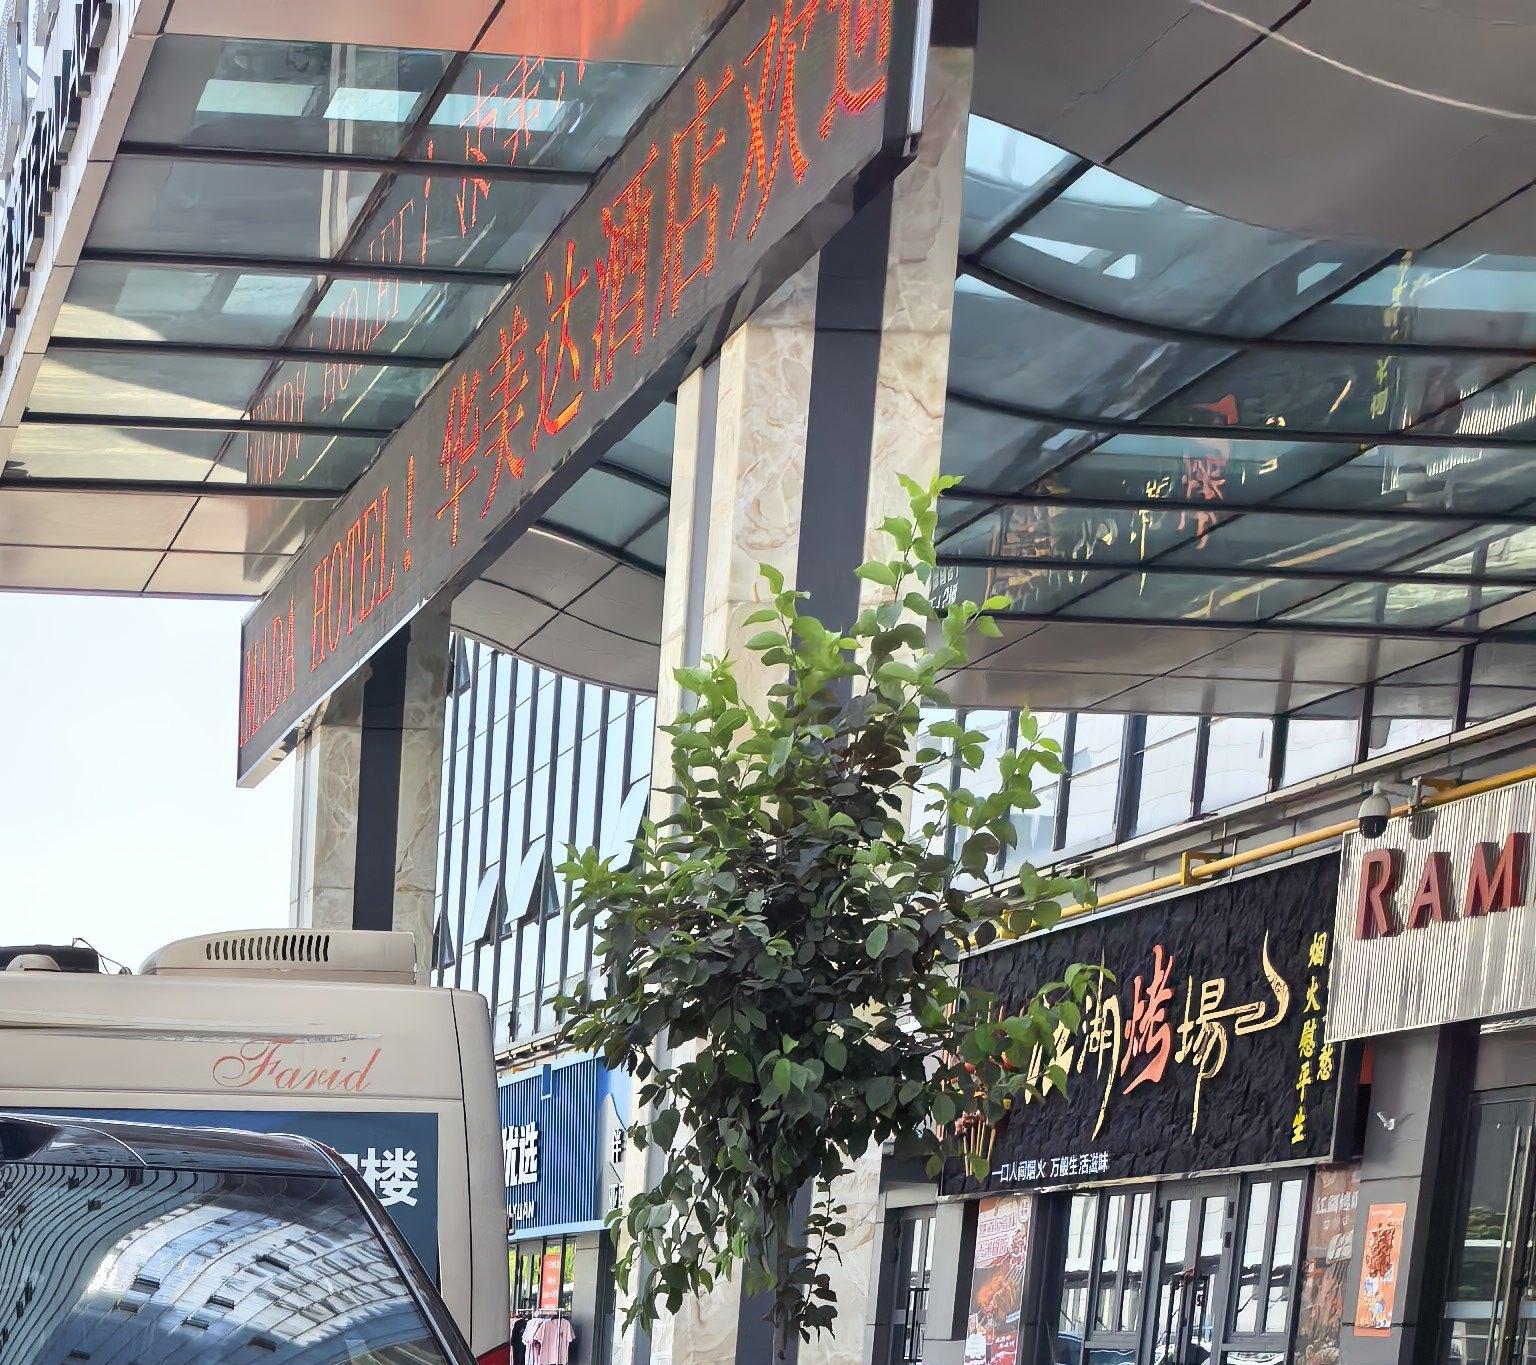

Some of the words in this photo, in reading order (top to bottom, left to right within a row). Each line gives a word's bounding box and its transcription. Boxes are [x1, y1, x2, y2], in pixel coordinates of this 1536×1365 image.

[240, 595, 295, 747] MADA
[1356, 831, 1534, 941] RAM
[212, 1037, 382, 1093] Farid
[1291, 932, 1328, 1144] 烟火慰平生
[340, 1148, 419, 1207] 楼
[992, 1159, 1047, 1182] 一口人间烟火
[1050, 1151, 1109, 1177] 万般生活滋味
